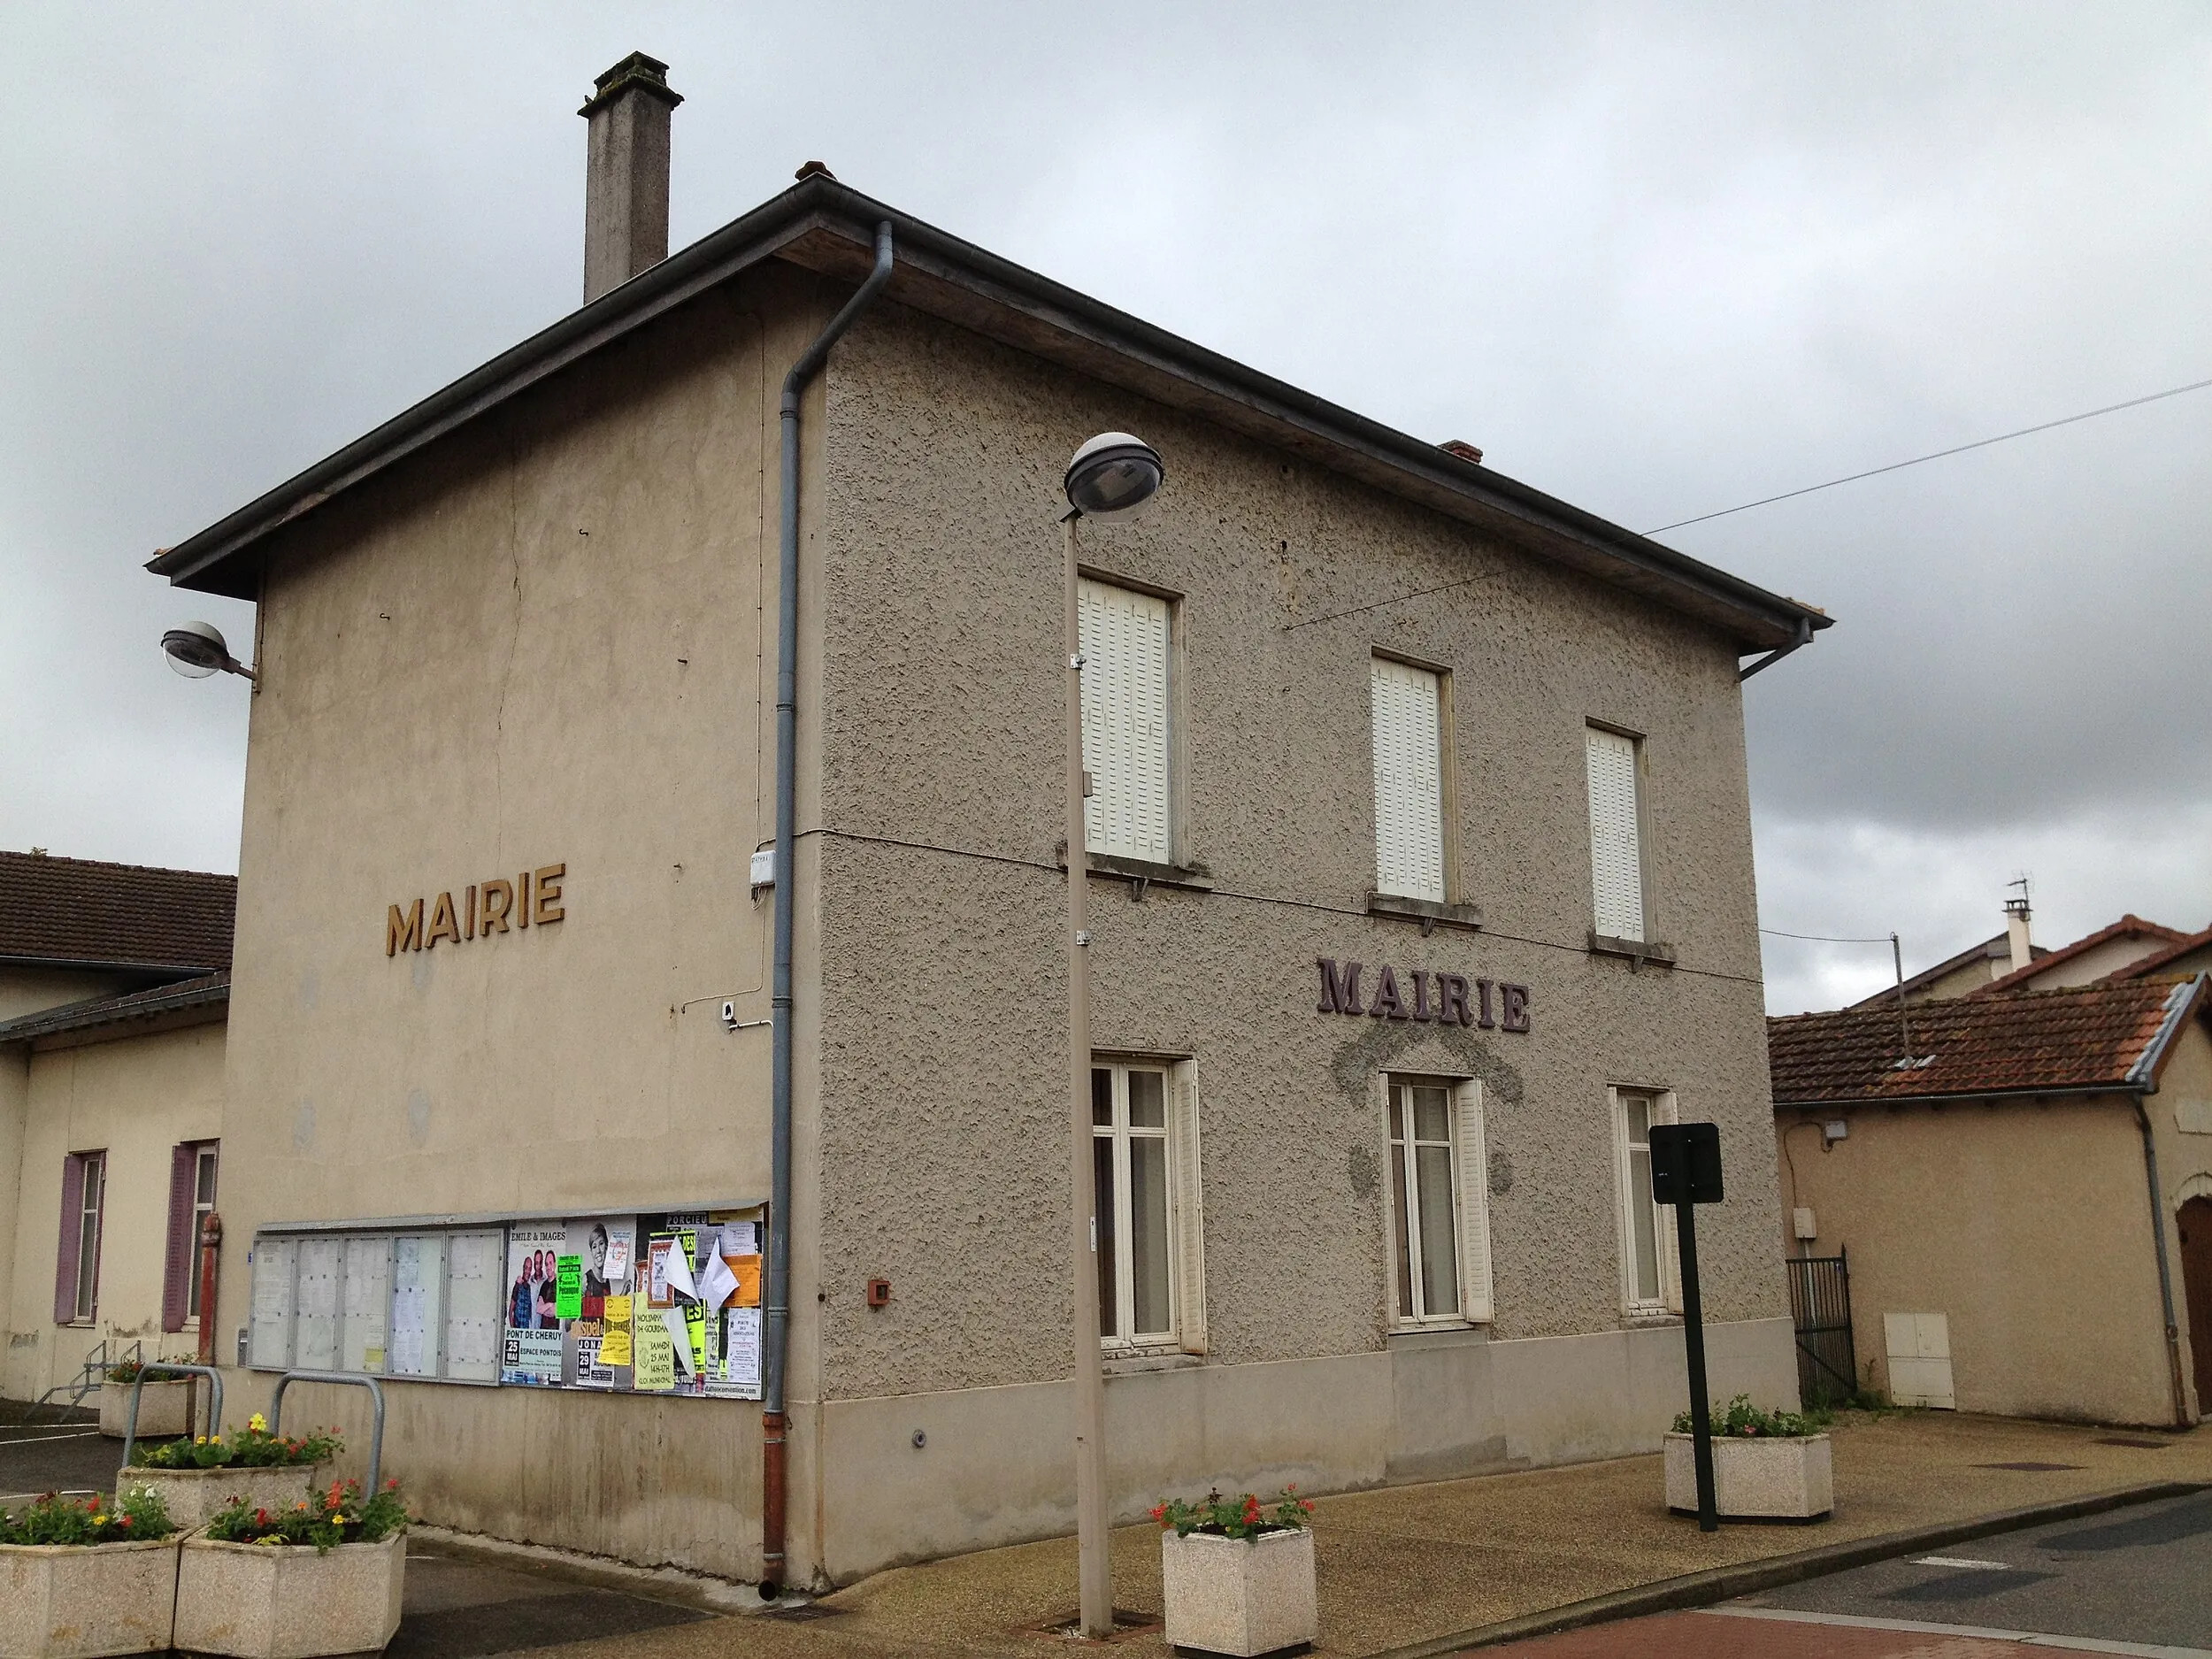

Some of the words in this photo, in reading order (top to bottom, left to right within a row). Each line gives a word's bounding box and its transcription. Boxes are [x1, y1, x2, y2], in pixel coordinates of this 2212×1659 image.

[386, 863, 566, 956] MAIRIE
[1317, 957, 1531, 1033] MAIRIE
[668, 1216, 707, 1225] PORCIEU
[511, 1233, 531, 1241] EMILE
[534, 1233, 539, 1241] &
[540, 1232, 566, 1240] IMAGES
[506, 1330, 525, 1339] PONT
[525, 1331, 534, 1340] DE
[535, 1331, 563, 1340] CHERUY
[508, 1341, 518, 1352] 25
[507, 1352, 518, 1361] MAI
[580, 1356, 589, 1365] 29
[657, 1353, 670, 1362] MAI
